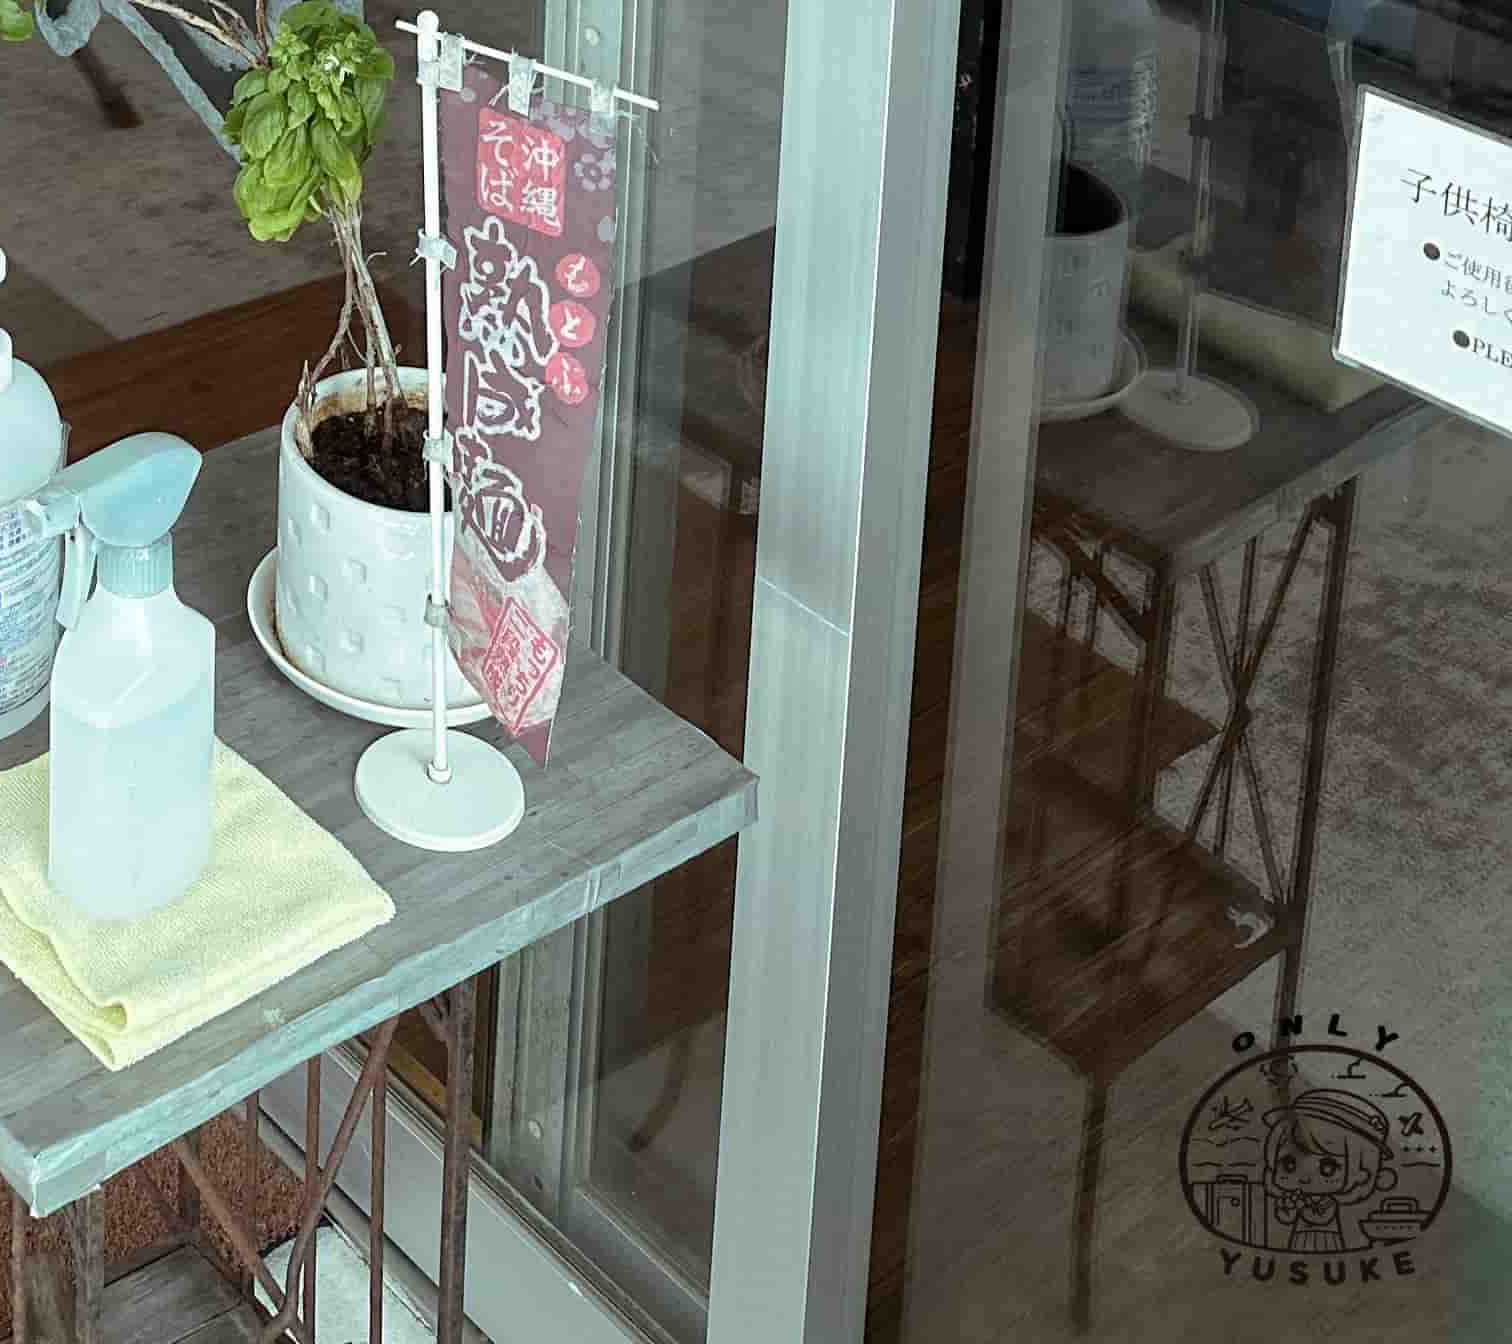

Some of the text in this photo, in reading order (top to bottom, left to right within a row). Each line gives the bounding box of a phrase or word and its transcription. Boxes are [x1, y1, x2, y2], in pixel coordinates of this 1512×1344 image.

[480, 118, 519, 213] そば
[520, 135, 562, 229] 沖縄
[1401, 168, 1512, 243] 子供椅
